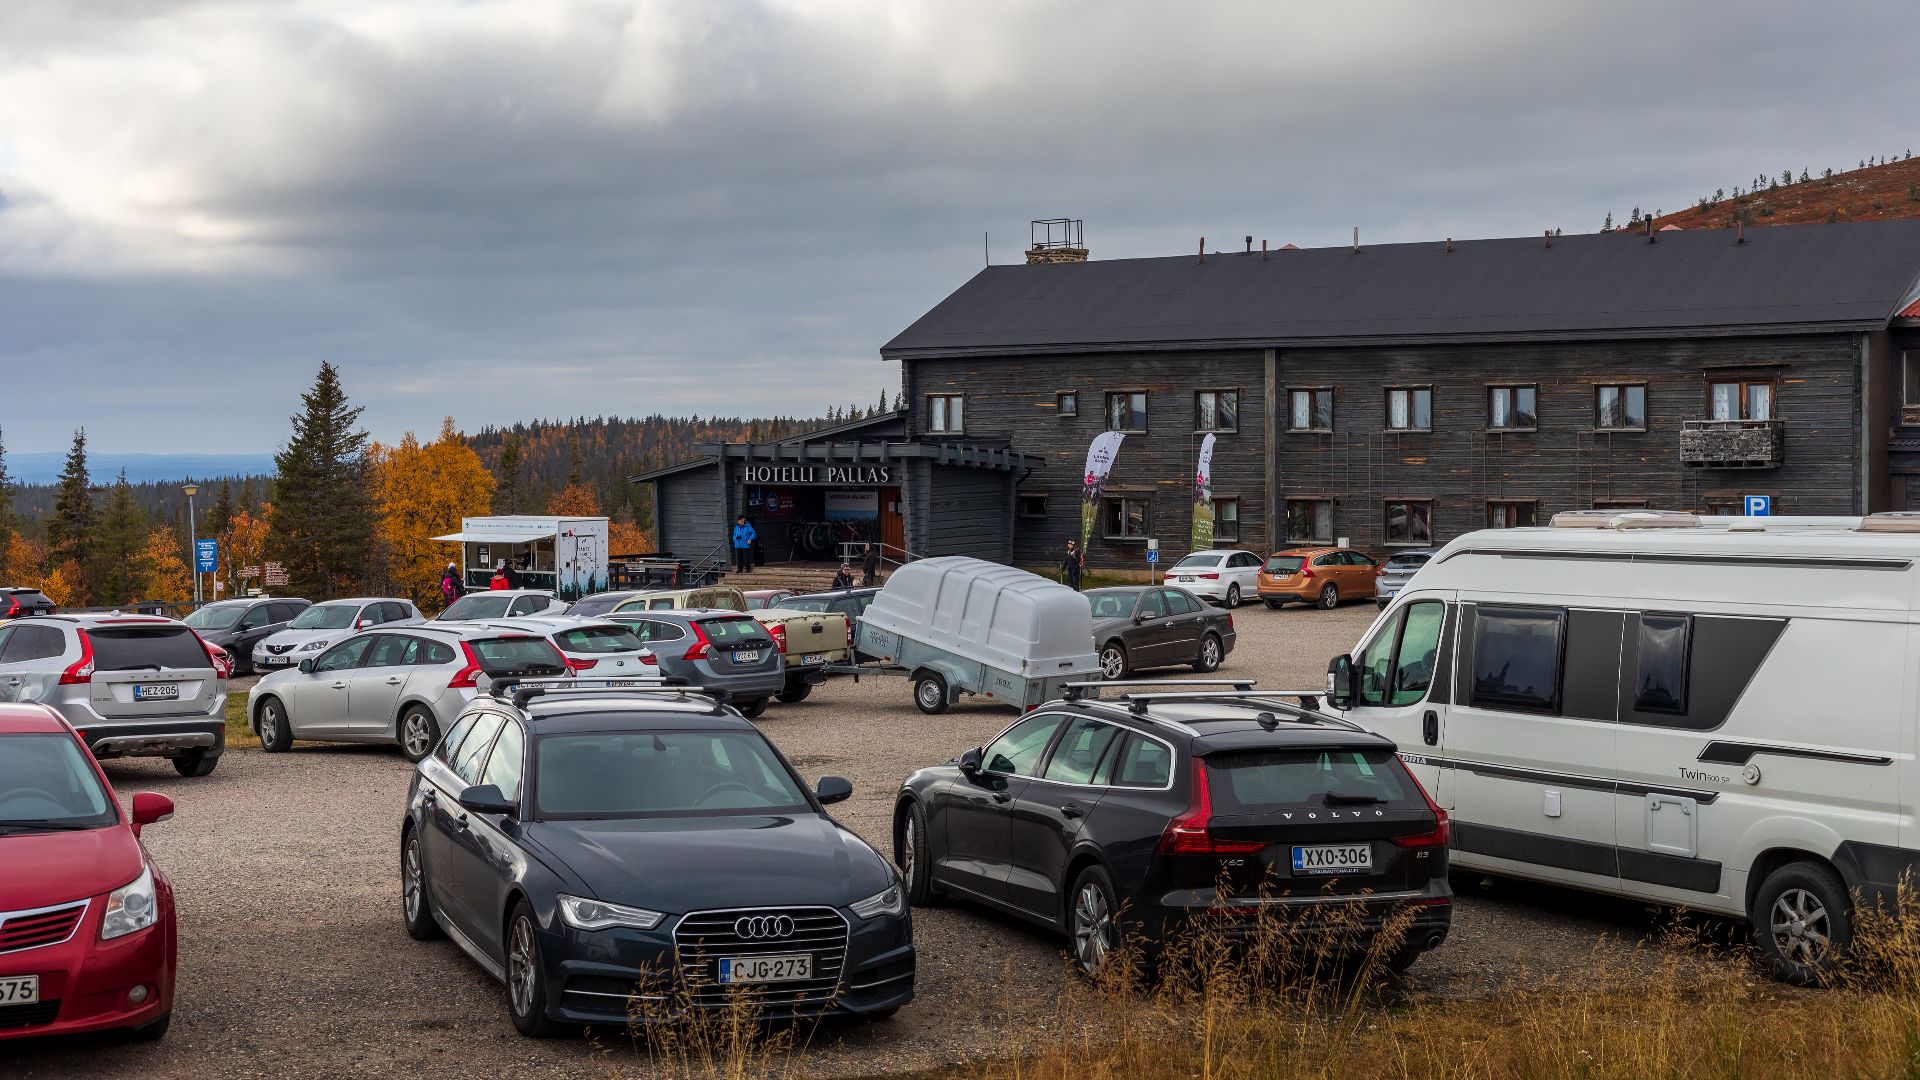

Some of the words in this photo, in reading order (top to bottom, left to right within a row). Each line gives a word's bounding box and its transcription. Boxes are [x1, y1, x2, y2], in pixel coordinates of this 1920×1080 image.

[745, 466, 813, 482] HOTELLI
[828, 466, 889, 483] PALLAS
[1750, 497, 1766, 516] P
[141, 685, 177, 696] HEZ-205
[1401, 755, 1427, 765] DRIA
[1678, 766, 1707, 782] Twin
[1283, 811, 1383, 819] VOLVO
[1304, 848, 1368, 866] XXO-306
[734, 959, 808, 978] CJG-273
